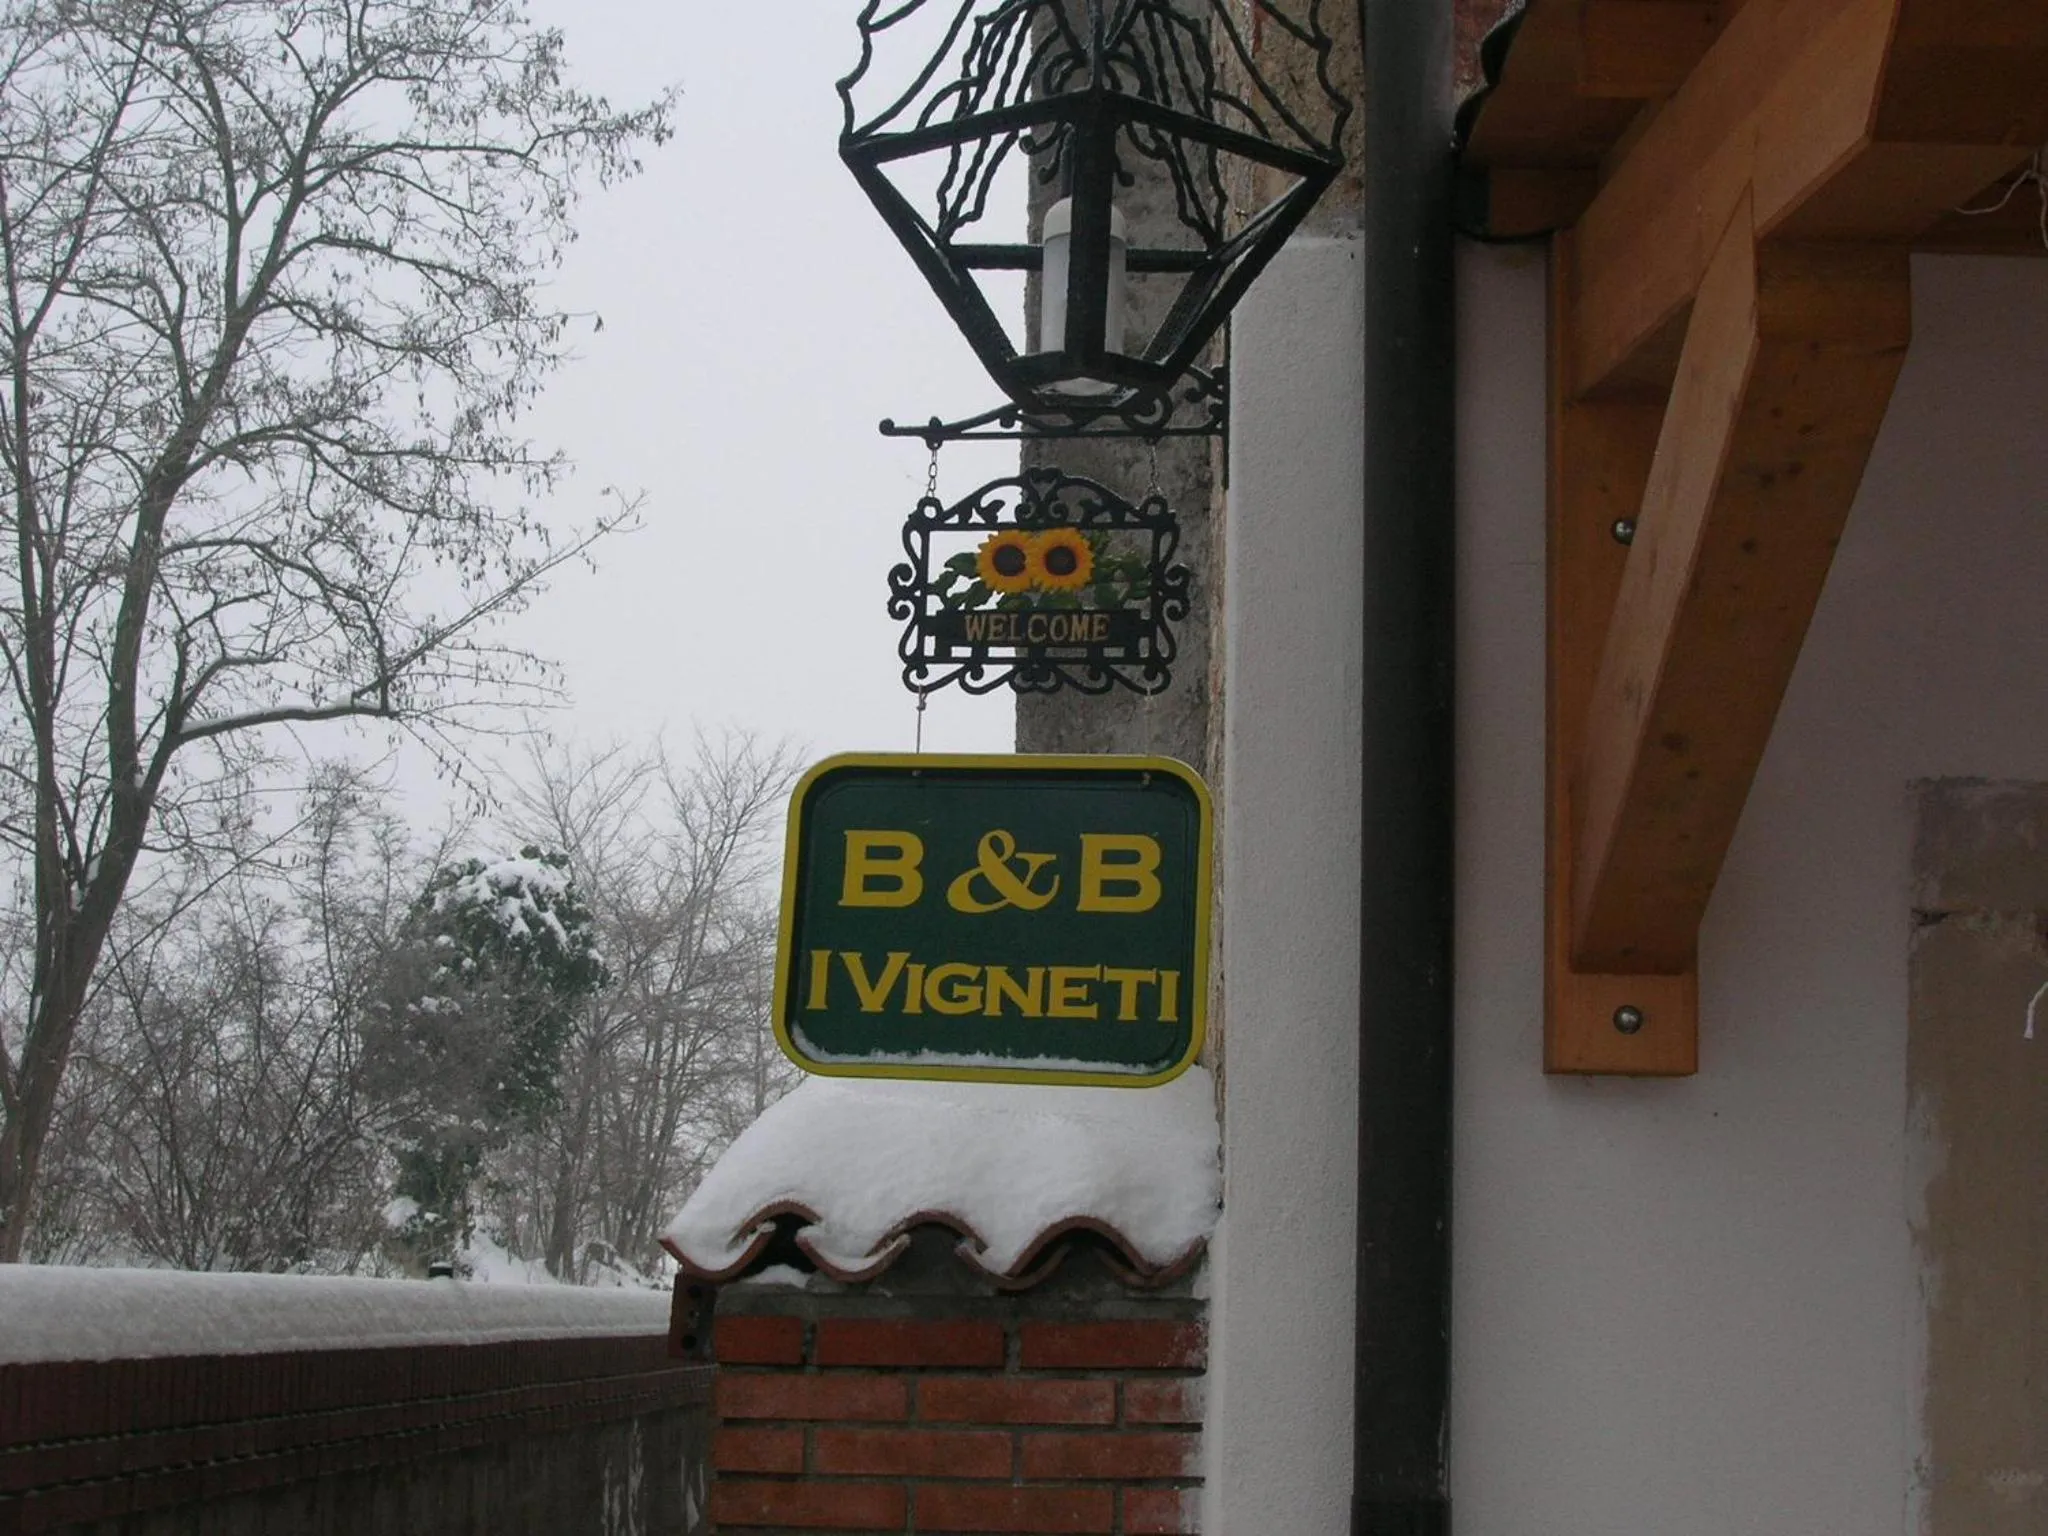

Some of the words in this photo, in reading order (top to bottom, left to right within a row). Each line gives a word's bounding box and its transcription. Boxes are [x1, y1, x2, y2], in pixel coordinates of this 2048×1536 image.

[964, 613, 1111, 642] WELCOME
[838, 829, 924, 908] B
[947, 829, 1060, 913] &
[1075, 833, 1162, 913] B
